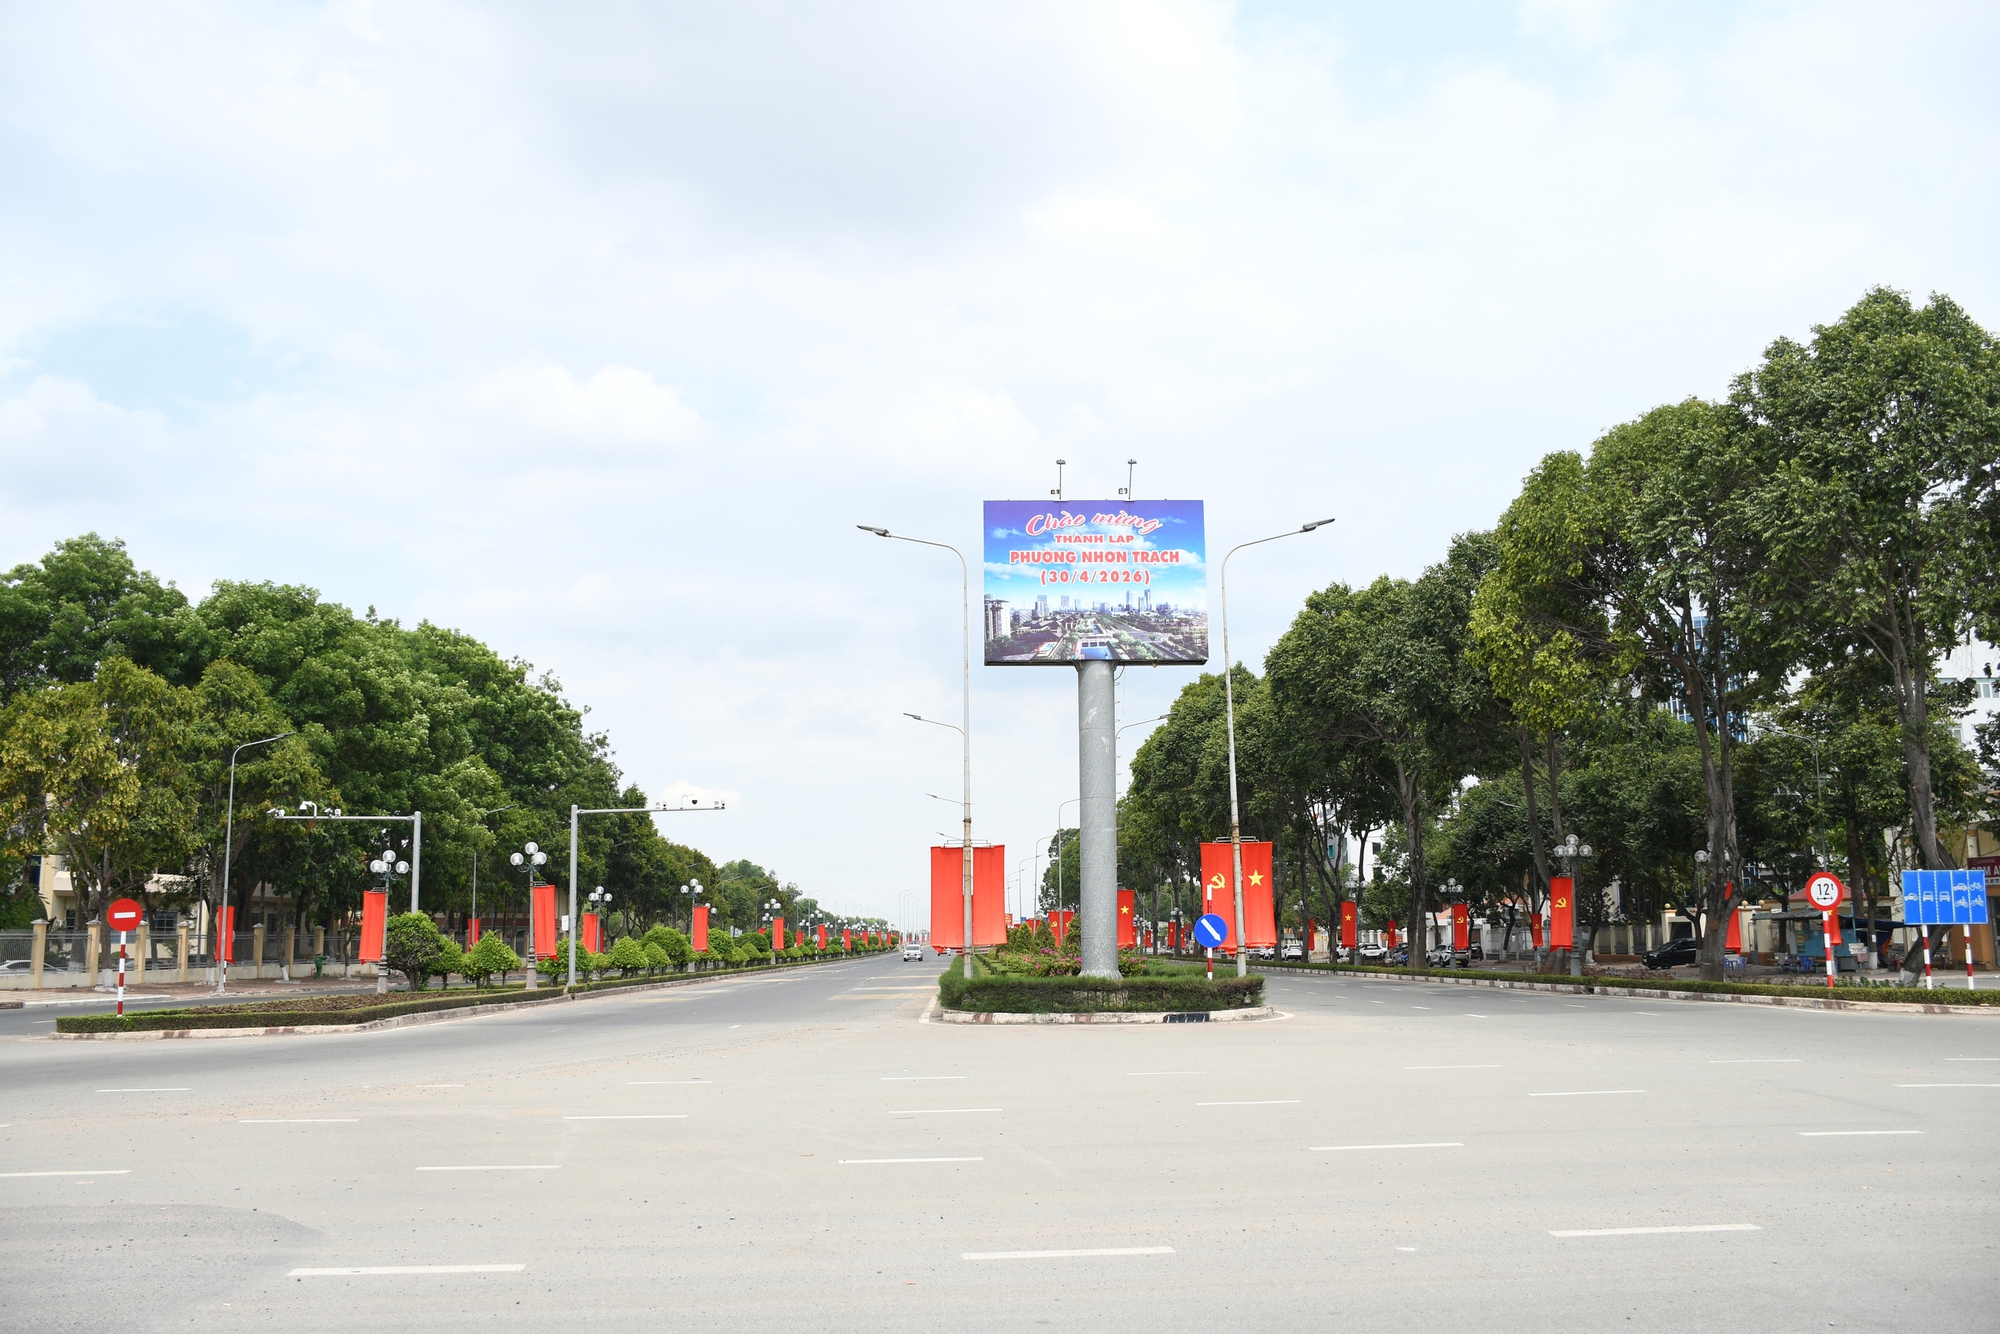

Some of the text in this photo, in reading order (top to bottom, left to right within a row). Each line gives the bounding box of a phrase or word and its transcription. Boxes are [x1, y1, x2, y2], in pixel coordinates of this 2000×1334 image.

[1026, 510, 1162, 535] Chào mừng
[1055, 534, 1135, 545] THÀNH LẬP
[1010, 549, 1180, 566] PHƯỜNG NHƠN TRẠCH
[1041, 570, 1150, 585] (30/4/2026)
